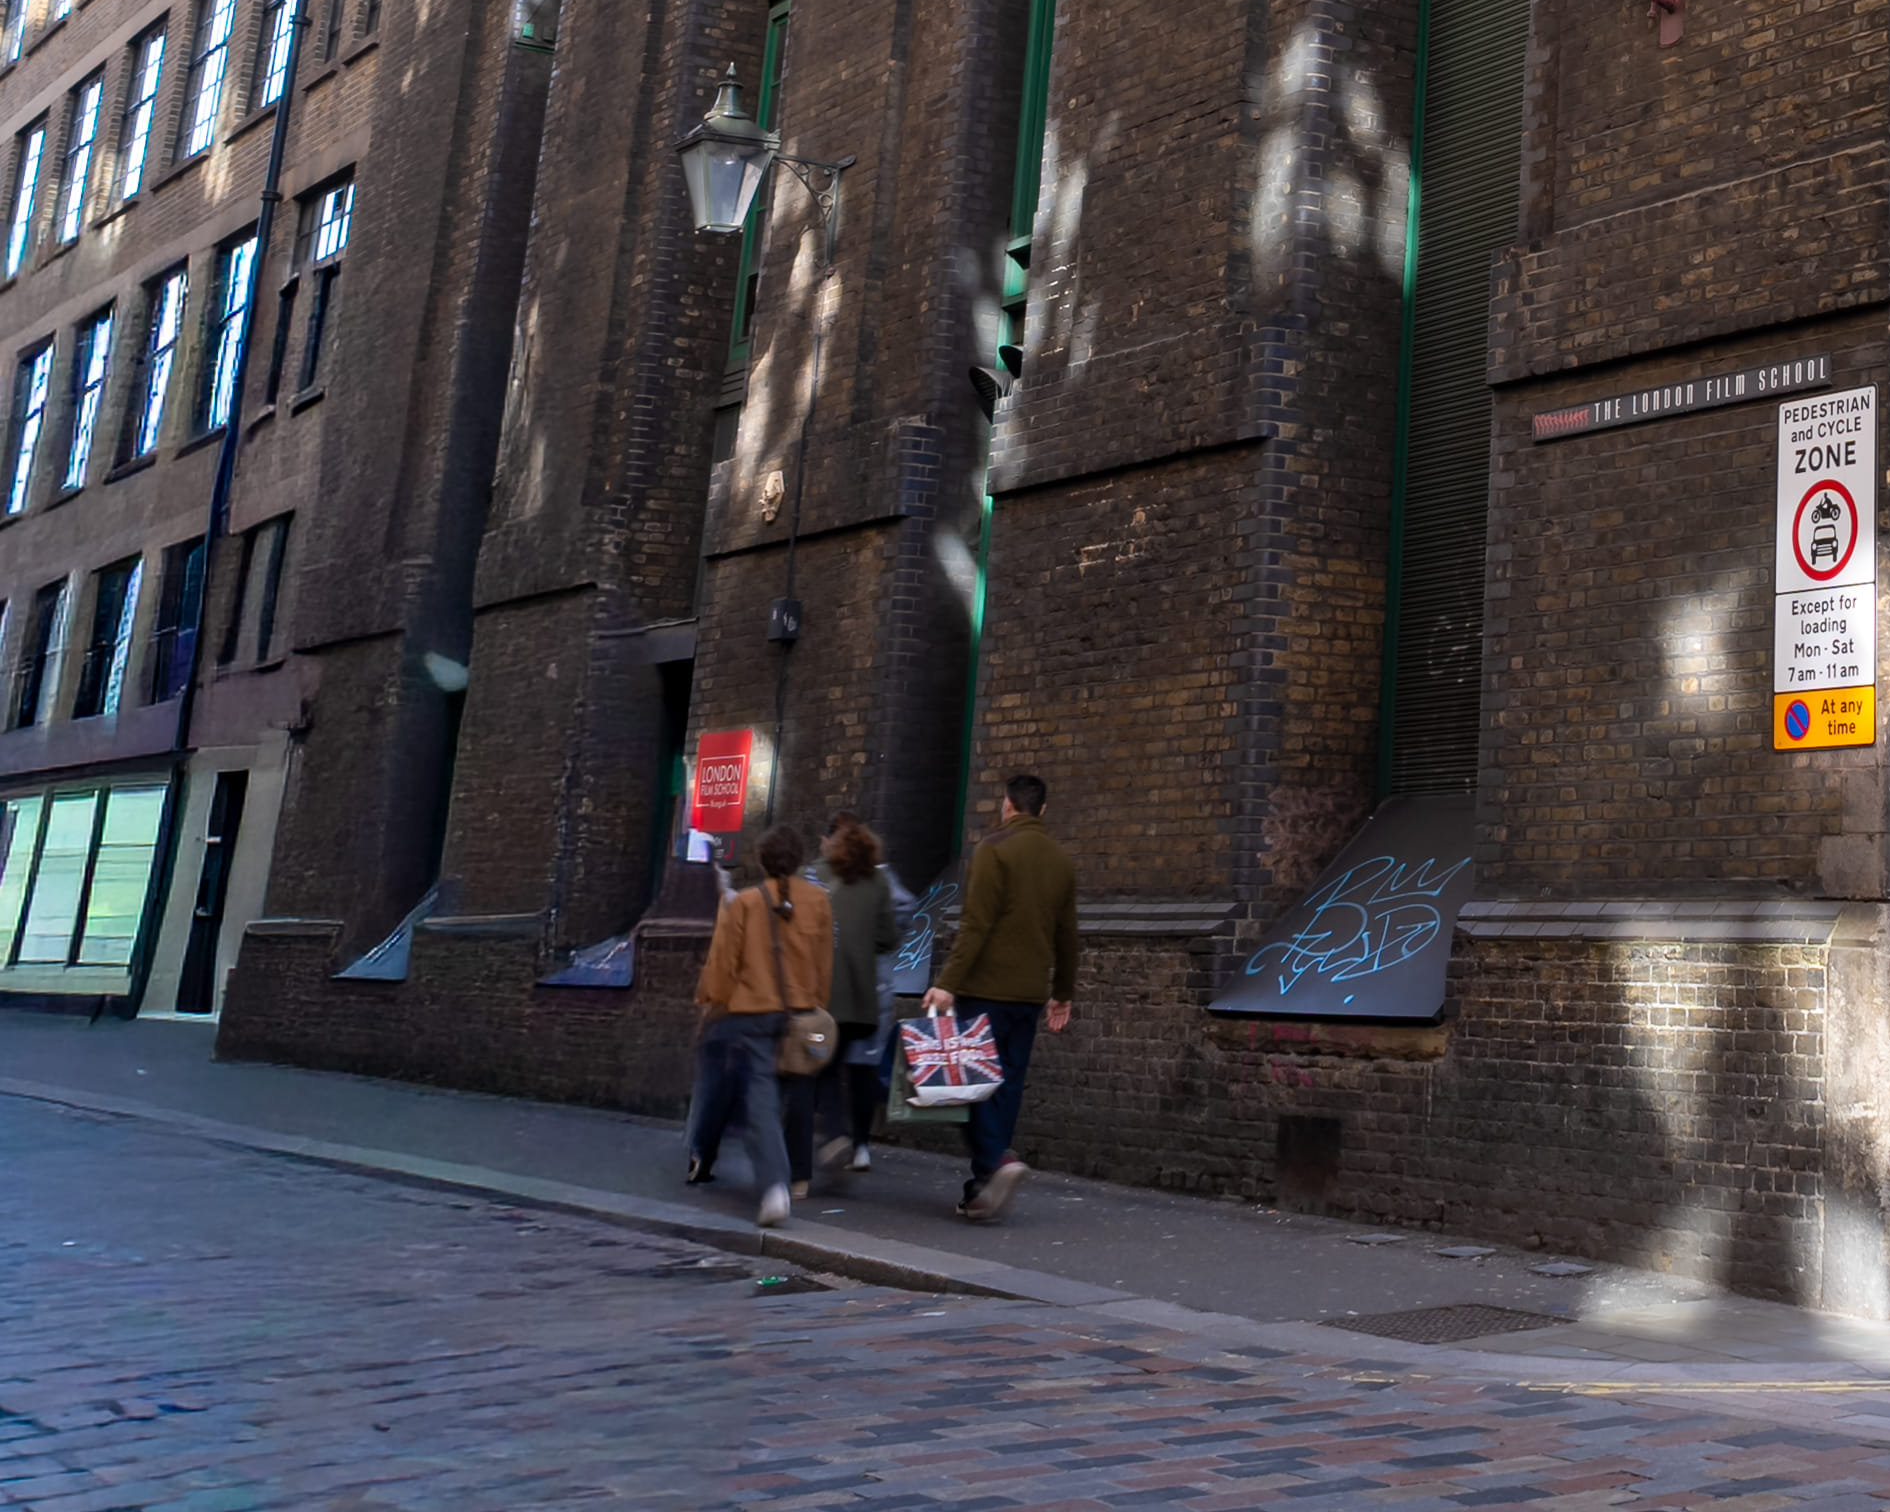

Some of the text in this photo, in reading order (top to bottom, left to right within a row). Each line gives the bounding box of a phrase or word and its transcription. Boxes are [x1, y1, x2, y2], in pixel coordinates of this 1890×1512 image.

[1594, 397, 1621, 423] THE
[1758, 357, 1826, 391] SCHOOL
[1784, 394, 1870, 424] PEDESTRIAN
[1791, 416, 1862, 443] and CYCLE
[1795, 440, 1856, 474] ZONE
[1791, 595, 1857, 616] Except for
[1801, 617, 1847, 635] loading
[1794, 643, 1821, 658] Mon
[1832, 638, 1854, 655] Sat
[1821, 699, 1863, 715] At any
[1828, 720, 1856, 735] time
[702, 764, 741, 783] LONDON
